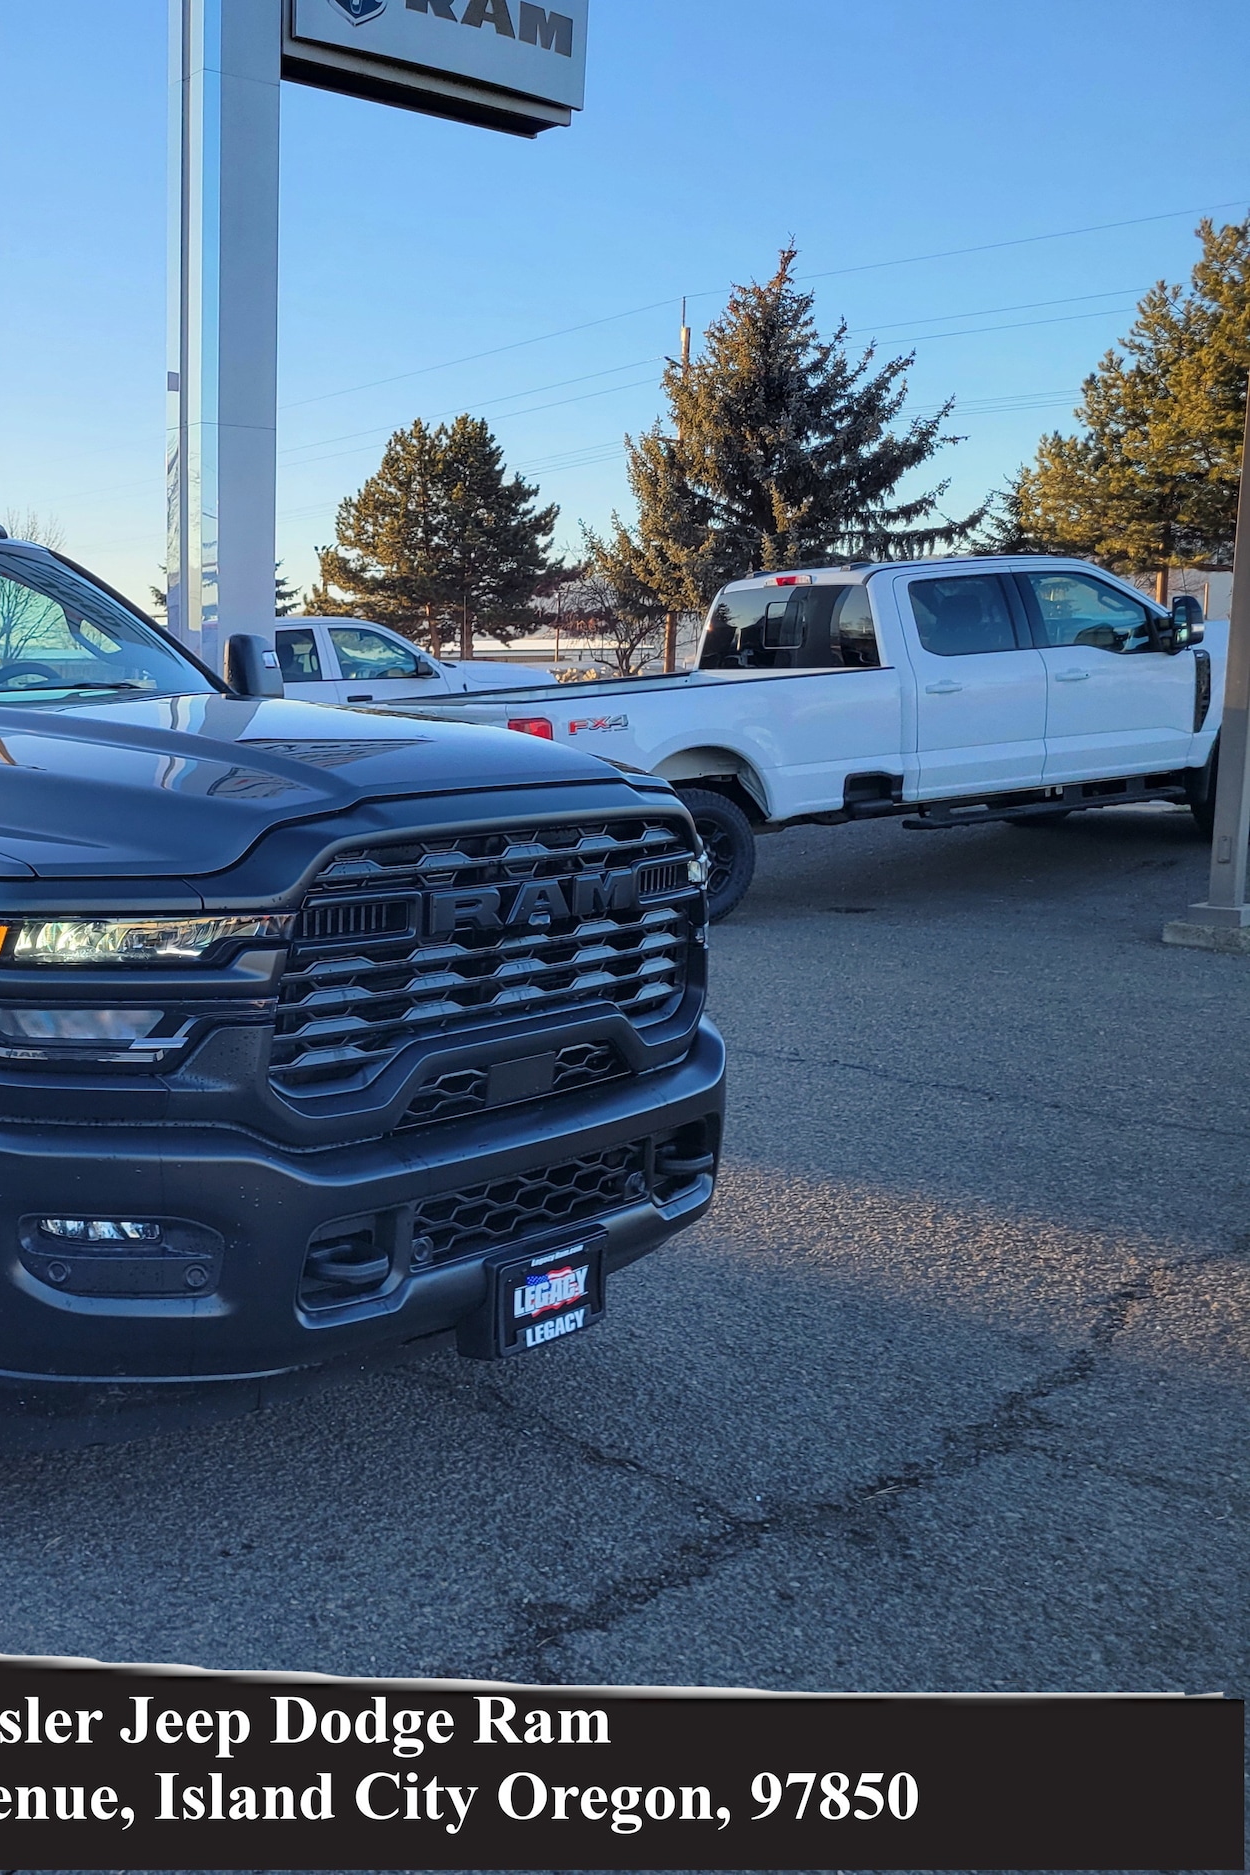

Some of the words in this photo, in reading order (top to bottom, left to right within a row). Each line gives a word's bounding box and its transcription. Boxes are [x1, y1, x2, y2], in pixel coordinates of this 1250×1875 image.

[568, 714, 628, 735] FX4
[430, 868, 632, 935] RAM
[514, 1267, 588, 1316] LEGACY
[526, 1308, 586, 1348] LEGACY
